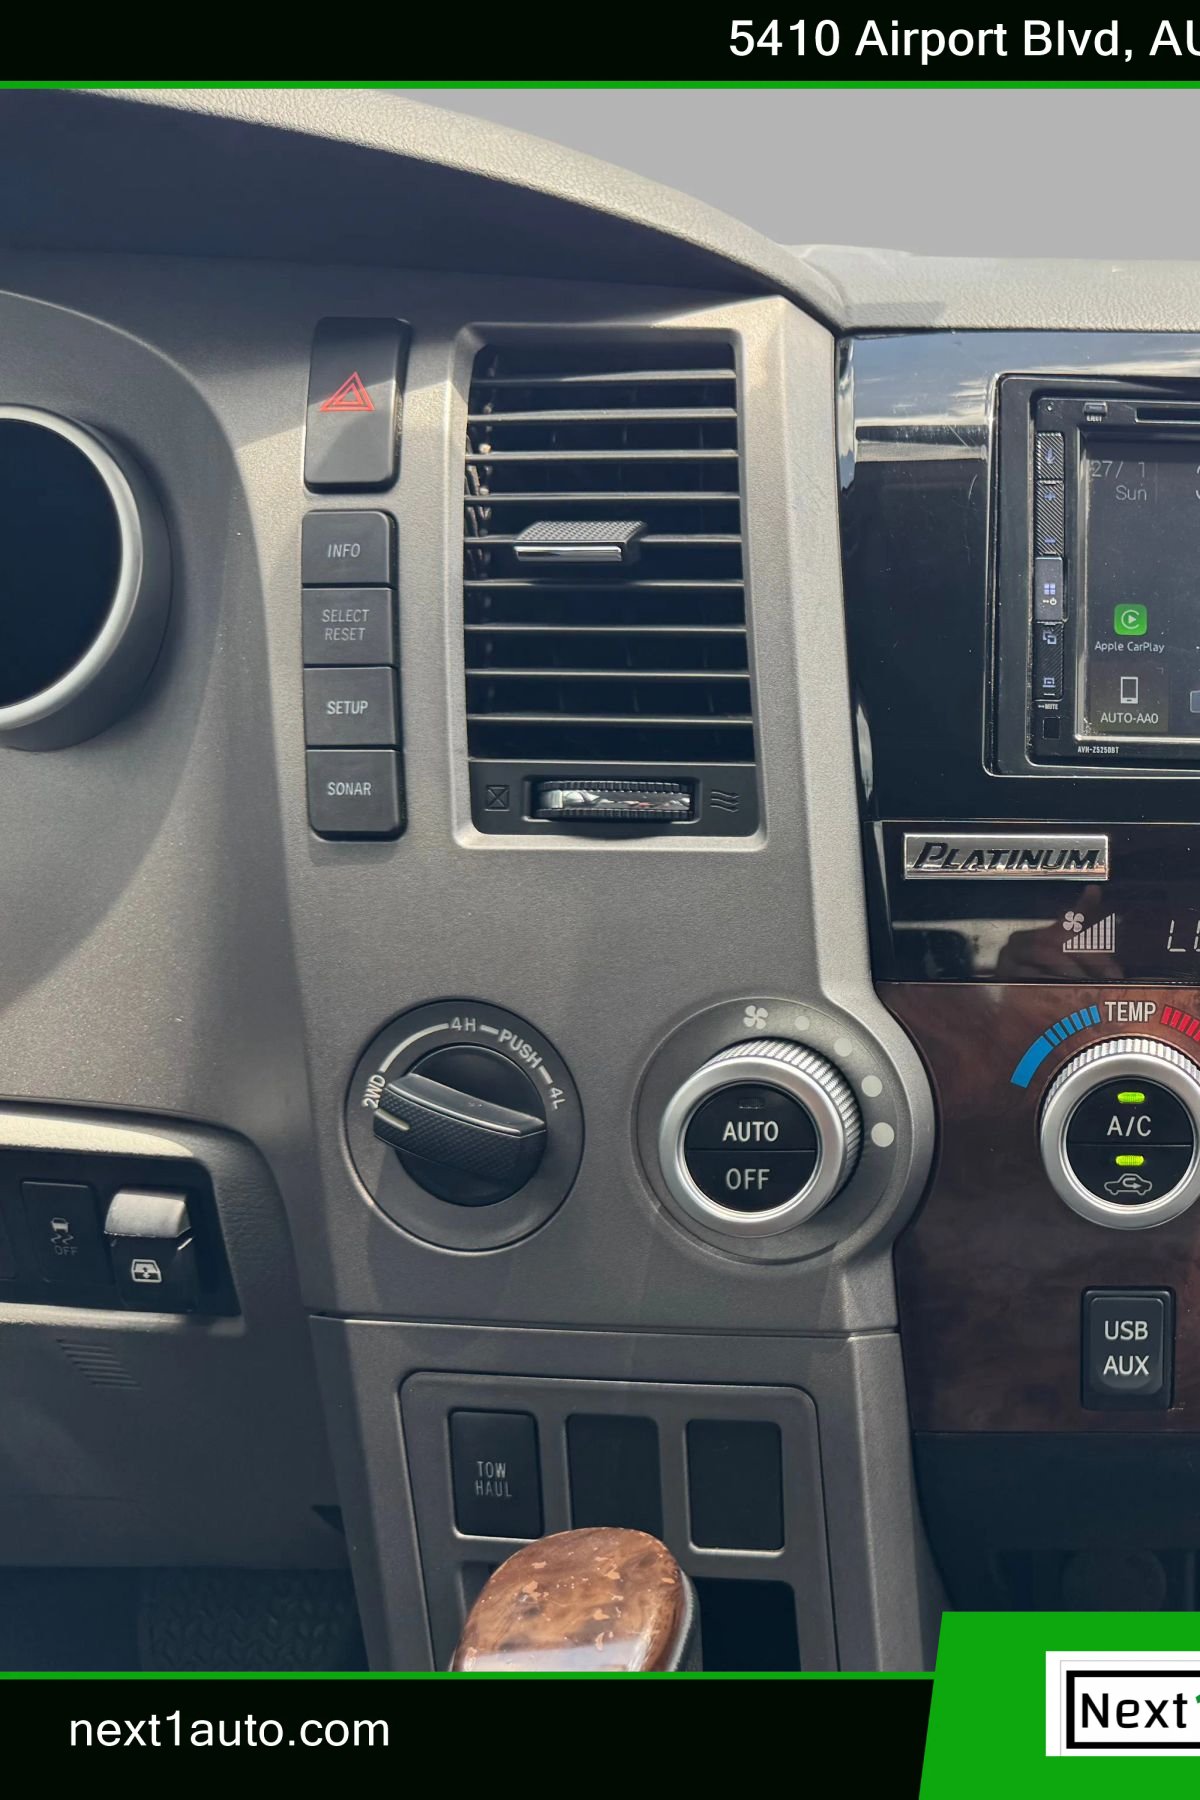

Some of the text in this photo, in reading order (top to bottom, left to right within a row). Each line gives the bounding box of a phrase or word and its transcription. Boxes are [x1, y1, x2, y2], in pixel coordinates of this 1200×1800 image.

[1115, 484, 1147, 501] Sun
[326, 542, 362, 559] INFO
[321, 608, 370, 624] SELECT
[324, 627, 366, 642] RESET
[1094, 641, 1165, 654] Apple CarPlay
[326, 699, 369, 715] SETUP
[326, 781, 372, 797] SONAR
[912, 840, 1102, 871] PLATINUM
[1104, 1000, 1157, 1022] TEMP
[450, 1016, 567, 1112] 4H PUSH 4L
[362, 1073, 387, 1111] 2WD
[721, 1119, 780, 1143] AUTO
[1106, 1115, 1152, 1138] A/C
[724, 1167, 771, 1190] OFF
[54, 1245, 78, 1257] OFF
[1103, 1320, 1149, 1341] USB
[1102, 1354, 1150, 1376] AUX
[476, 1460, 507, 1479] TOW
[475, 1480, 513, 1499] HAUL
